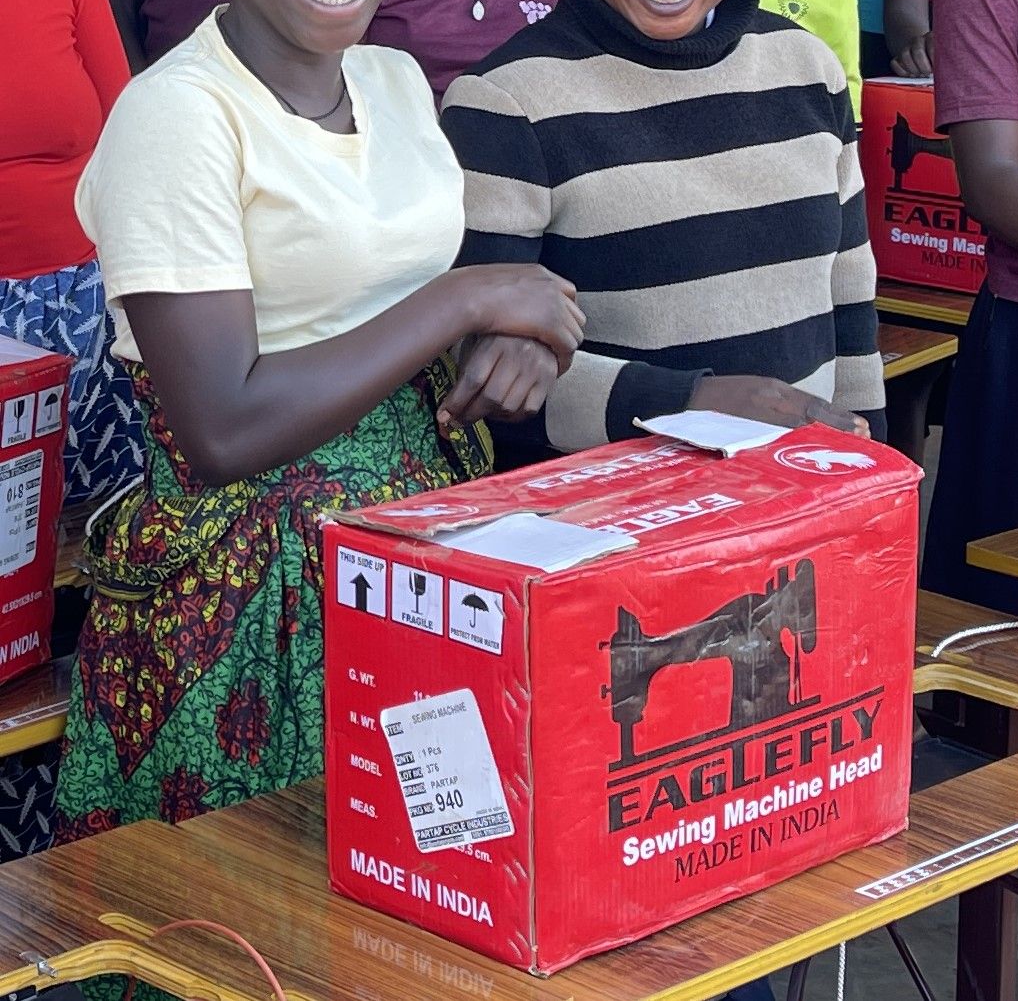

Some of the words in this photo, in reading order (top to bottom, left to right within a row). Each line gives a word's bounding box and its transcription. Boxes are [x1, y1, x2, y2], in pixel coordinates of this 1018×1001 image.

[891, 228, 949, 253] Sewing
[921, 250, 963, 271] MADE
[339, 550, 356, 564] THIS
[357, 555, 373, 570] SIDE
[374, 562, 385, 573] UP
[401, 611, 434, 630] FRAGILE
[10, 630, 40, 660] INDIA
[450, 627, 470, 640] PROTECT
[348, 668, 358, 682] G.
[359, 671, 376, 688] WT.
[349, 711, 359, 725] N.
[360, 715, 377, 732] WT.
[350, 753, 382, 777] MODEL
[608, 698, 885, 834] EAGLEFLY
[430, 775, 459, 789] PARTAP
[350, 796, 379, 819] MEAS.
[435, 789, 464, 812] 940
[622, 814, 717, 868] Sewing
[723, 774, 824, 831] Machine
[829, 744, 884, 792] Head
[673, 833, 744, 884] MADE
[749, 822, 774, 854] IN
[780, 798, 841, 844] INDIA
[351, 848, 407, 892] MADE
[411, 875, 431, 903] IN
[437, 882, 494, 928] INDIA
